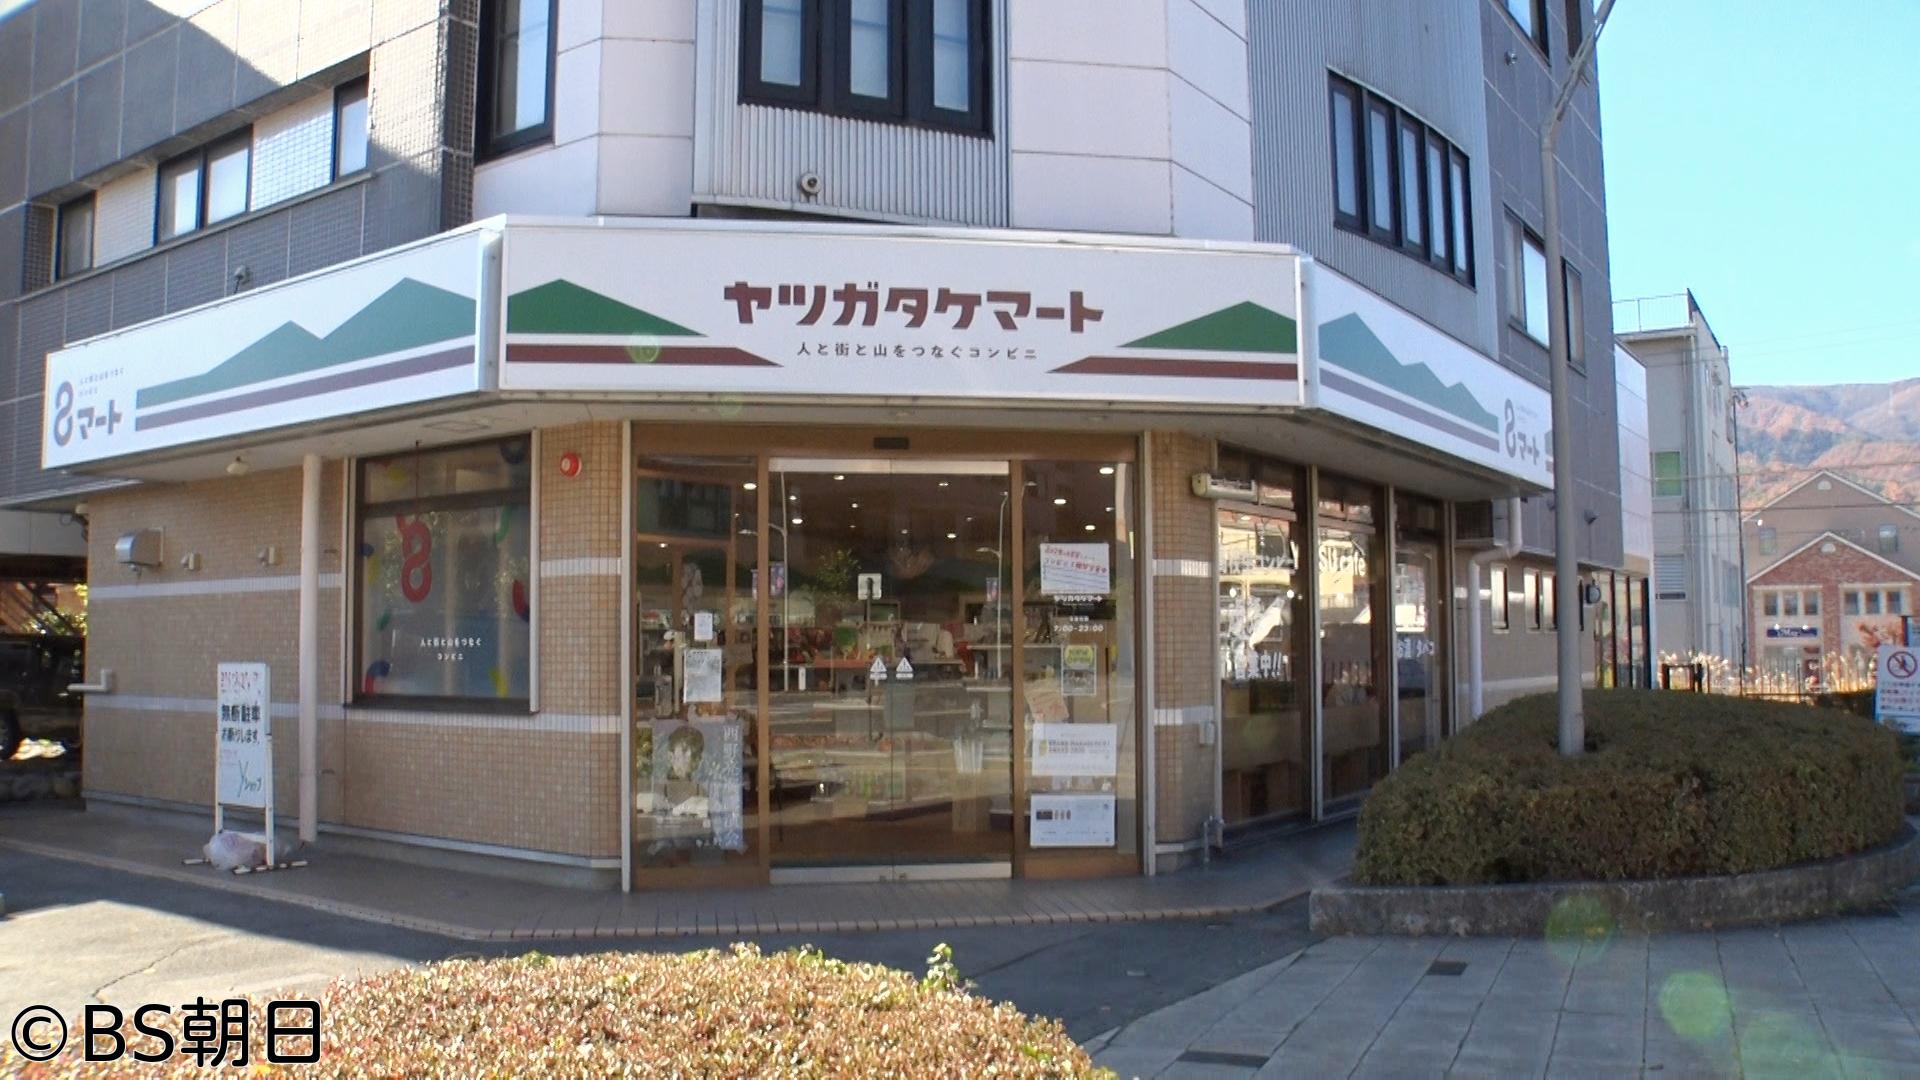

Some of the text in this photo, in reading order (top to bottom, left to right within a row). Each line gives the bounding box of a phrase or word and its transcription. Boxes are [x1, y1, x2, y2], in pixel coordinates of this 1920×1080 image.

[723, 281, 1104, 333] ヤツガタケマート
[796, 342, 1038, 360] 人と街と山をつなぐコンビニ
